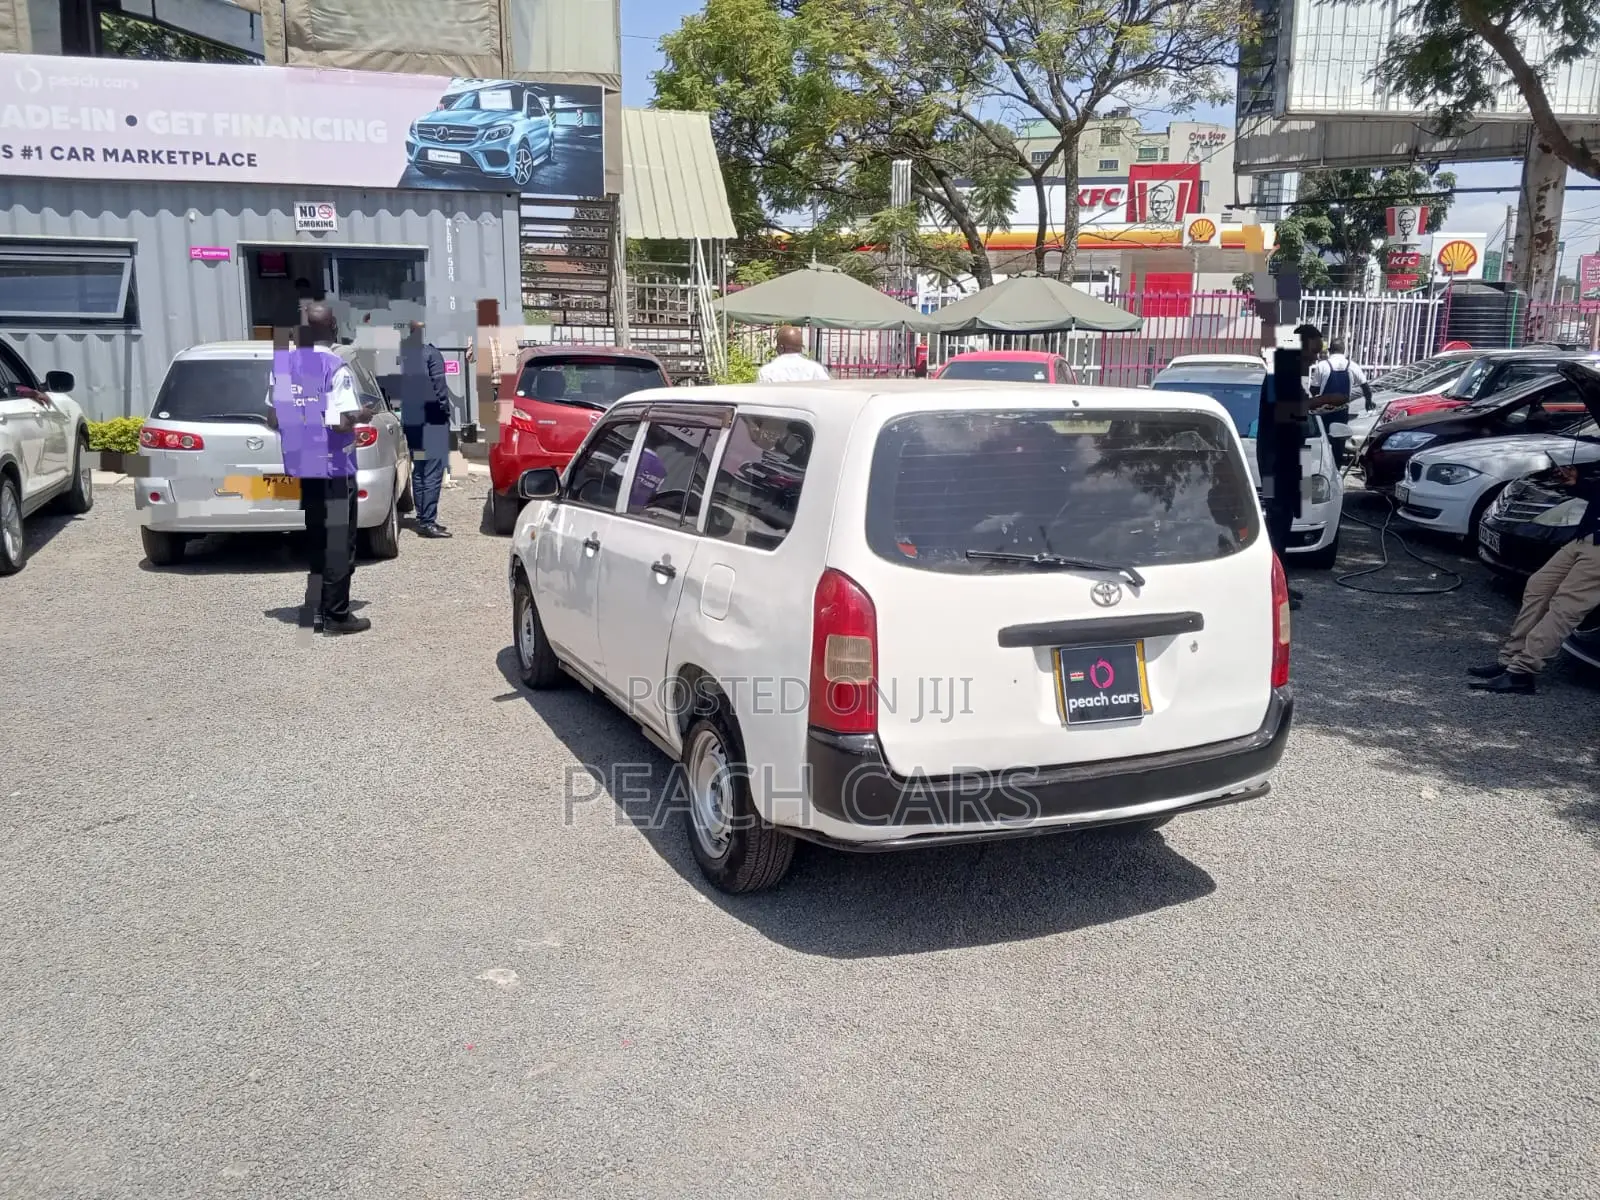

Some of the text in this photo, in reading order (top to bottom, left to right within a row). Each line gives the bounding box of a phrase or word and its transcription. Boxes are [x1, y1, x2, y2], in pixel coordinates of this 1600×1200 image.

[48, 73, 140, 90] peach cars
[147, 109, 208, 136] GET
[213, 112, 388, 144] FINANCING
[1188, 131, 1227, 142] One Stop
[21, 145, 43, 161] #1
[50, 146, 96, 163] CAR
[103, 148, 258, 168] MARKETPLACE
[300, 205, 316, 218] NO
[298, 220, 334, 228] SMOKING
[1390, 256, 1417, 265] KFC
[1068, 691, 1140, 713] peach cars
